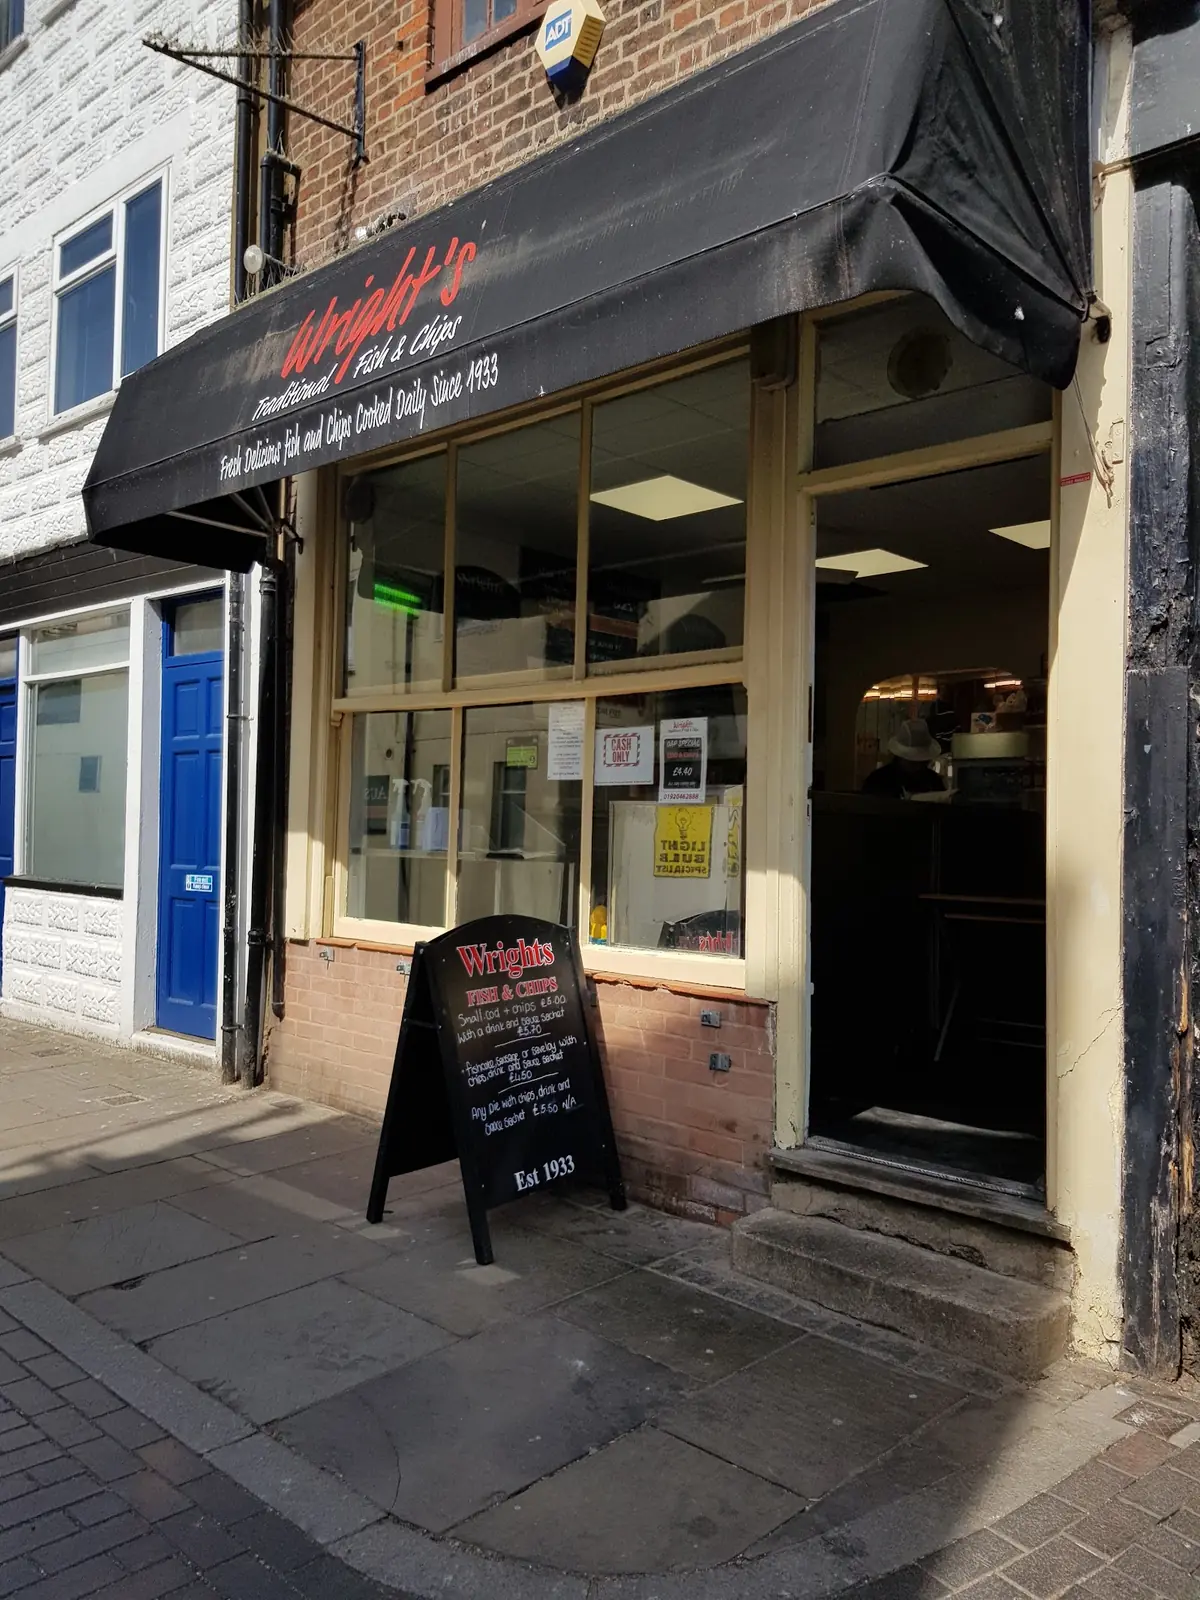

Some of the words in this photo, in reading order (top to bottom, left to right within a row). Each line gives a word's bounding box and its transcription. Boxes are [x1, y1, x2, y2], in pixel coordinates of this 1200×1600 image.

[545, 15, 571, 45] ADT
[281, 237, 476, 384] Wright's
[252, 363, 338, 421] Traditional
[353, 336, 393, 379] Fish
[391, 335, 407, 362] &
[409, 315, 462, 355] Chips
[220, 445, 241, 480] Fresh
[244, 438, 281, 473] Delicious
[303, 414, 324, 452] and
[326, 408, 352, 451] Chips
[356, 387, 393, 434] Cooked
[395, 378, 427, 429] Daily
[431, 371, 463, 406] Since
[466, 353, 499, 393] 1933
[611, 738, 632, 751] CASH
[612, 751, 630, 763] ONLY
[673, 766, 692, 776] £4.40
[456, 938, 555, 979] Wrights
[466, 986, 500, 1007] FISH
[502, 984, 514, 1001] &
[515, 976, 559, 998] CHIPS
[503, 1007, 510, 1015] +
[512, 1002, 537, 1014] chips
[541, 995, 566, 1008] £5.00
[477, 1028, 485, 1037] a
[485, 1022, 506, 1034] drink
[506, 1018, 519, 1028] and
[517, 1024, 542, 1037] £5.70
[522, 1050, 529, 1059] or
[559, 1035, 578, 1047] with
[508, 1061, 521, 1072] and
[471, 1106, 487, 1122] Any
[502, 1095, 517, 1109] with
[538, 1082, 557, 1097] drink
[558, 1078, 571, 1091] and
[562, 1094, 577, 1110] N/A
[513, 1168, 541, 1191] Est
[543, 1154, 575, 1181] 1933
